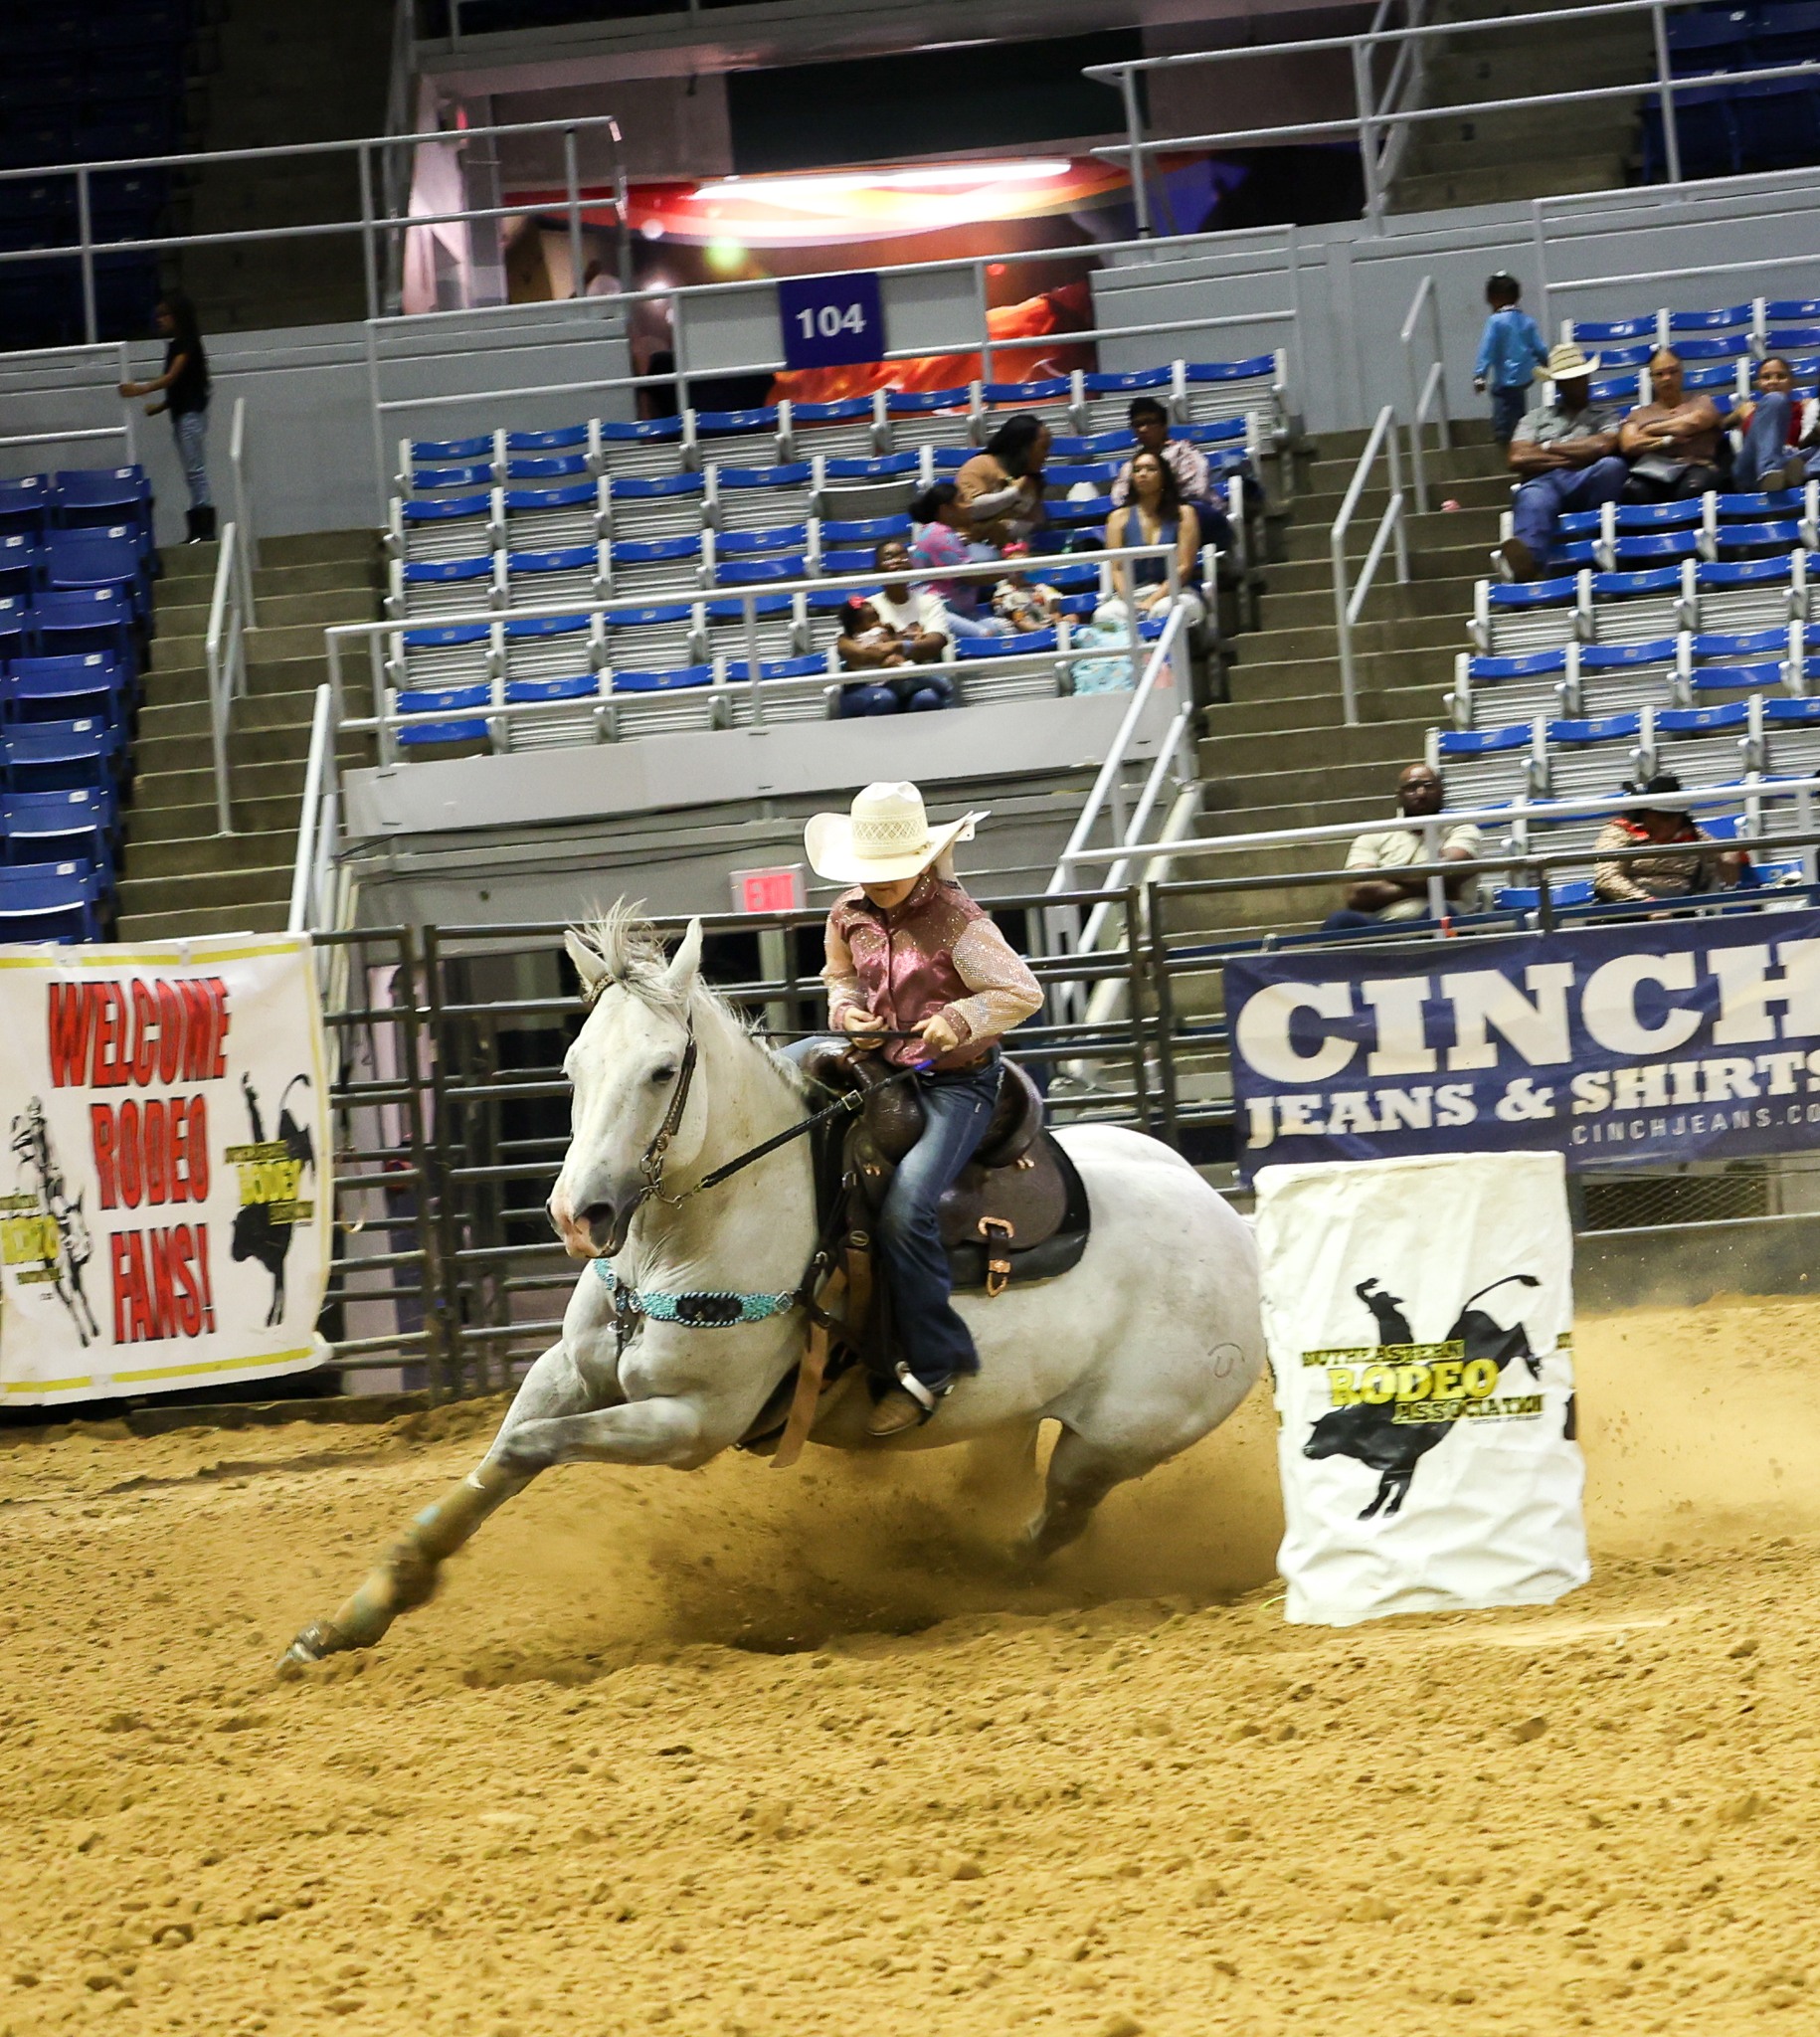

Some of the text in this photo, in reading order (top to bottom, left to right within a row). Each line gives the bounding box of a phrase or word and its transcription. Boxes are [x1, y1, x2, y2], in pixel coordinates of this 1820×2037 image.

[796, 302, 867, 339] 104
[48, 977, 230, 1088] WELCOME
[1236, 938, 1820, 1084] CINCH
[90, 1094, 212, 1210] RODEO
[1245, 1083, 1479, 1150] JEANS
[1495, 1078, 1555, 1123] &
[109, 1222, 216, 1345] FANS!
[1328, 1359, 1500, 1407] RODEO
